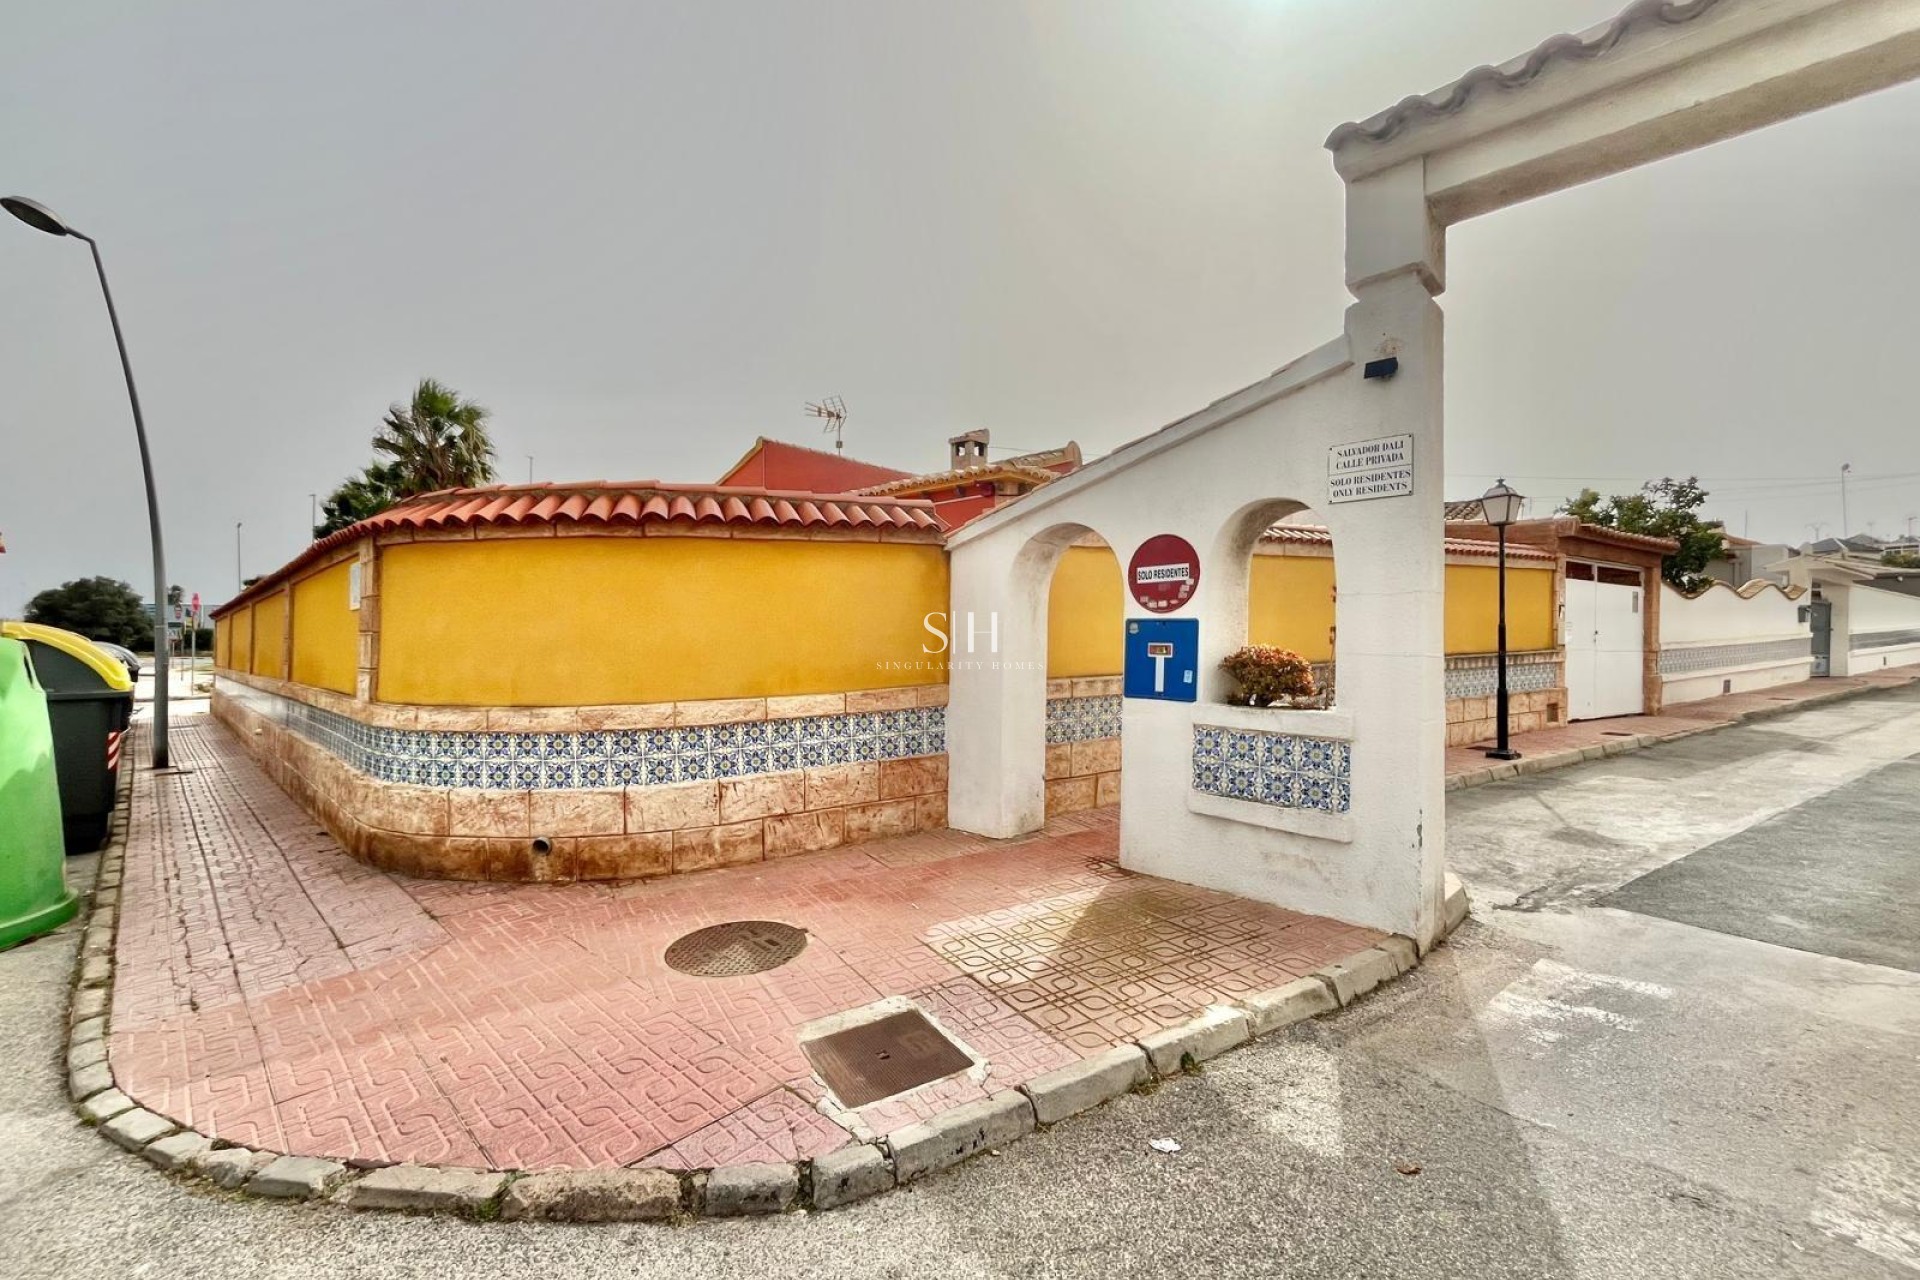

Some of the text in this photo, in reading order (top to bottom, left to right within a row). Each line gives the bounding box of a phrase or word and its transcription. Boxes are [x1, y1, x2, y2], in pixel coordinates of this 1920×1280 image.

[1337, 440, 1404, 457] SALVADOR DALI
[1336, 453, 1404, 469] CALLE PRIVADA
[1330, 471, 1411, 487] SOLO RESIDENTES
[1333, 482, 1407, 497] ONLY RESIDENTS
[1138, 567, 1189, 581] SOLO RESIDENTES
